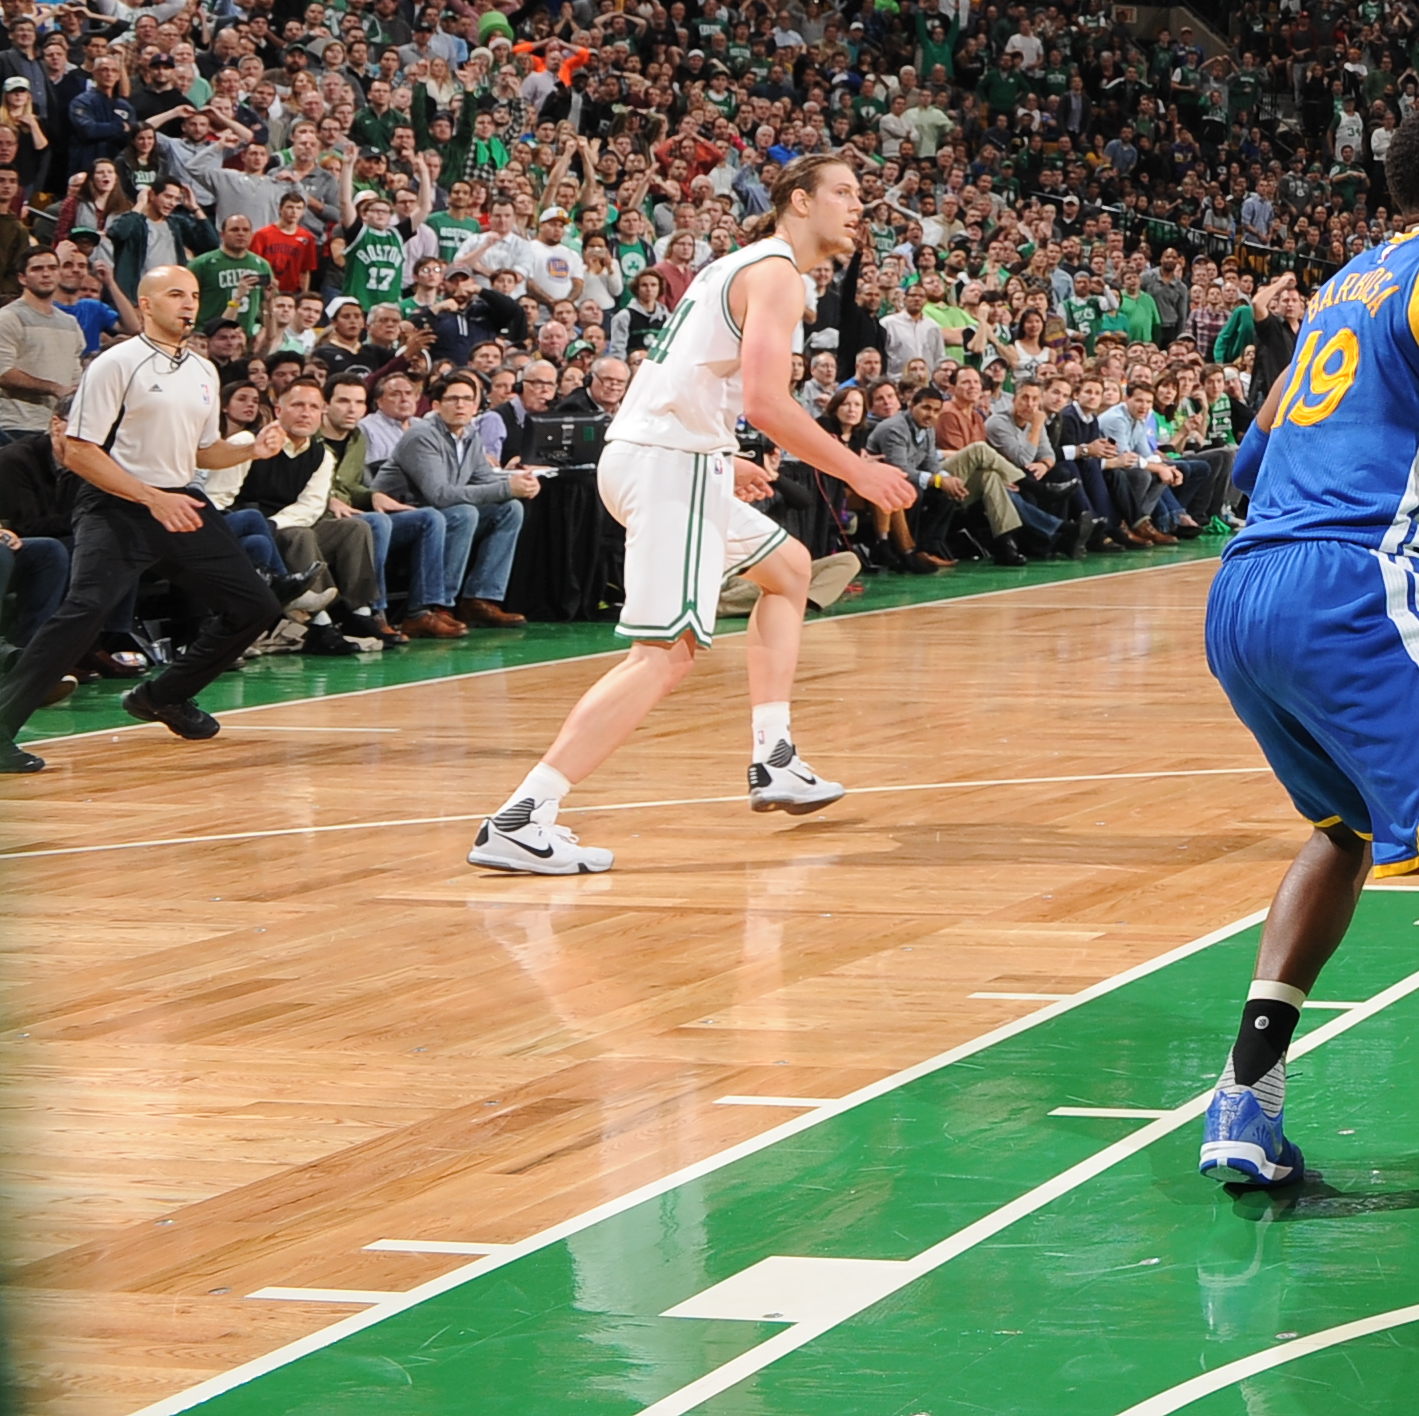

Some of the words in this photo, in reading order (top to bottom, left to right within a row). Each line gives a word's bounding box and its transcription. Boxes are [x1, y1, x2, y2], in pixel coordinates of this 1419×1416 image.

[356, 244, 402, 268] BOSTON
[218, 268, 260, 288] CELT
[366, 267, 396, 291] 17
[1270, 327, 1360, 429] 19
